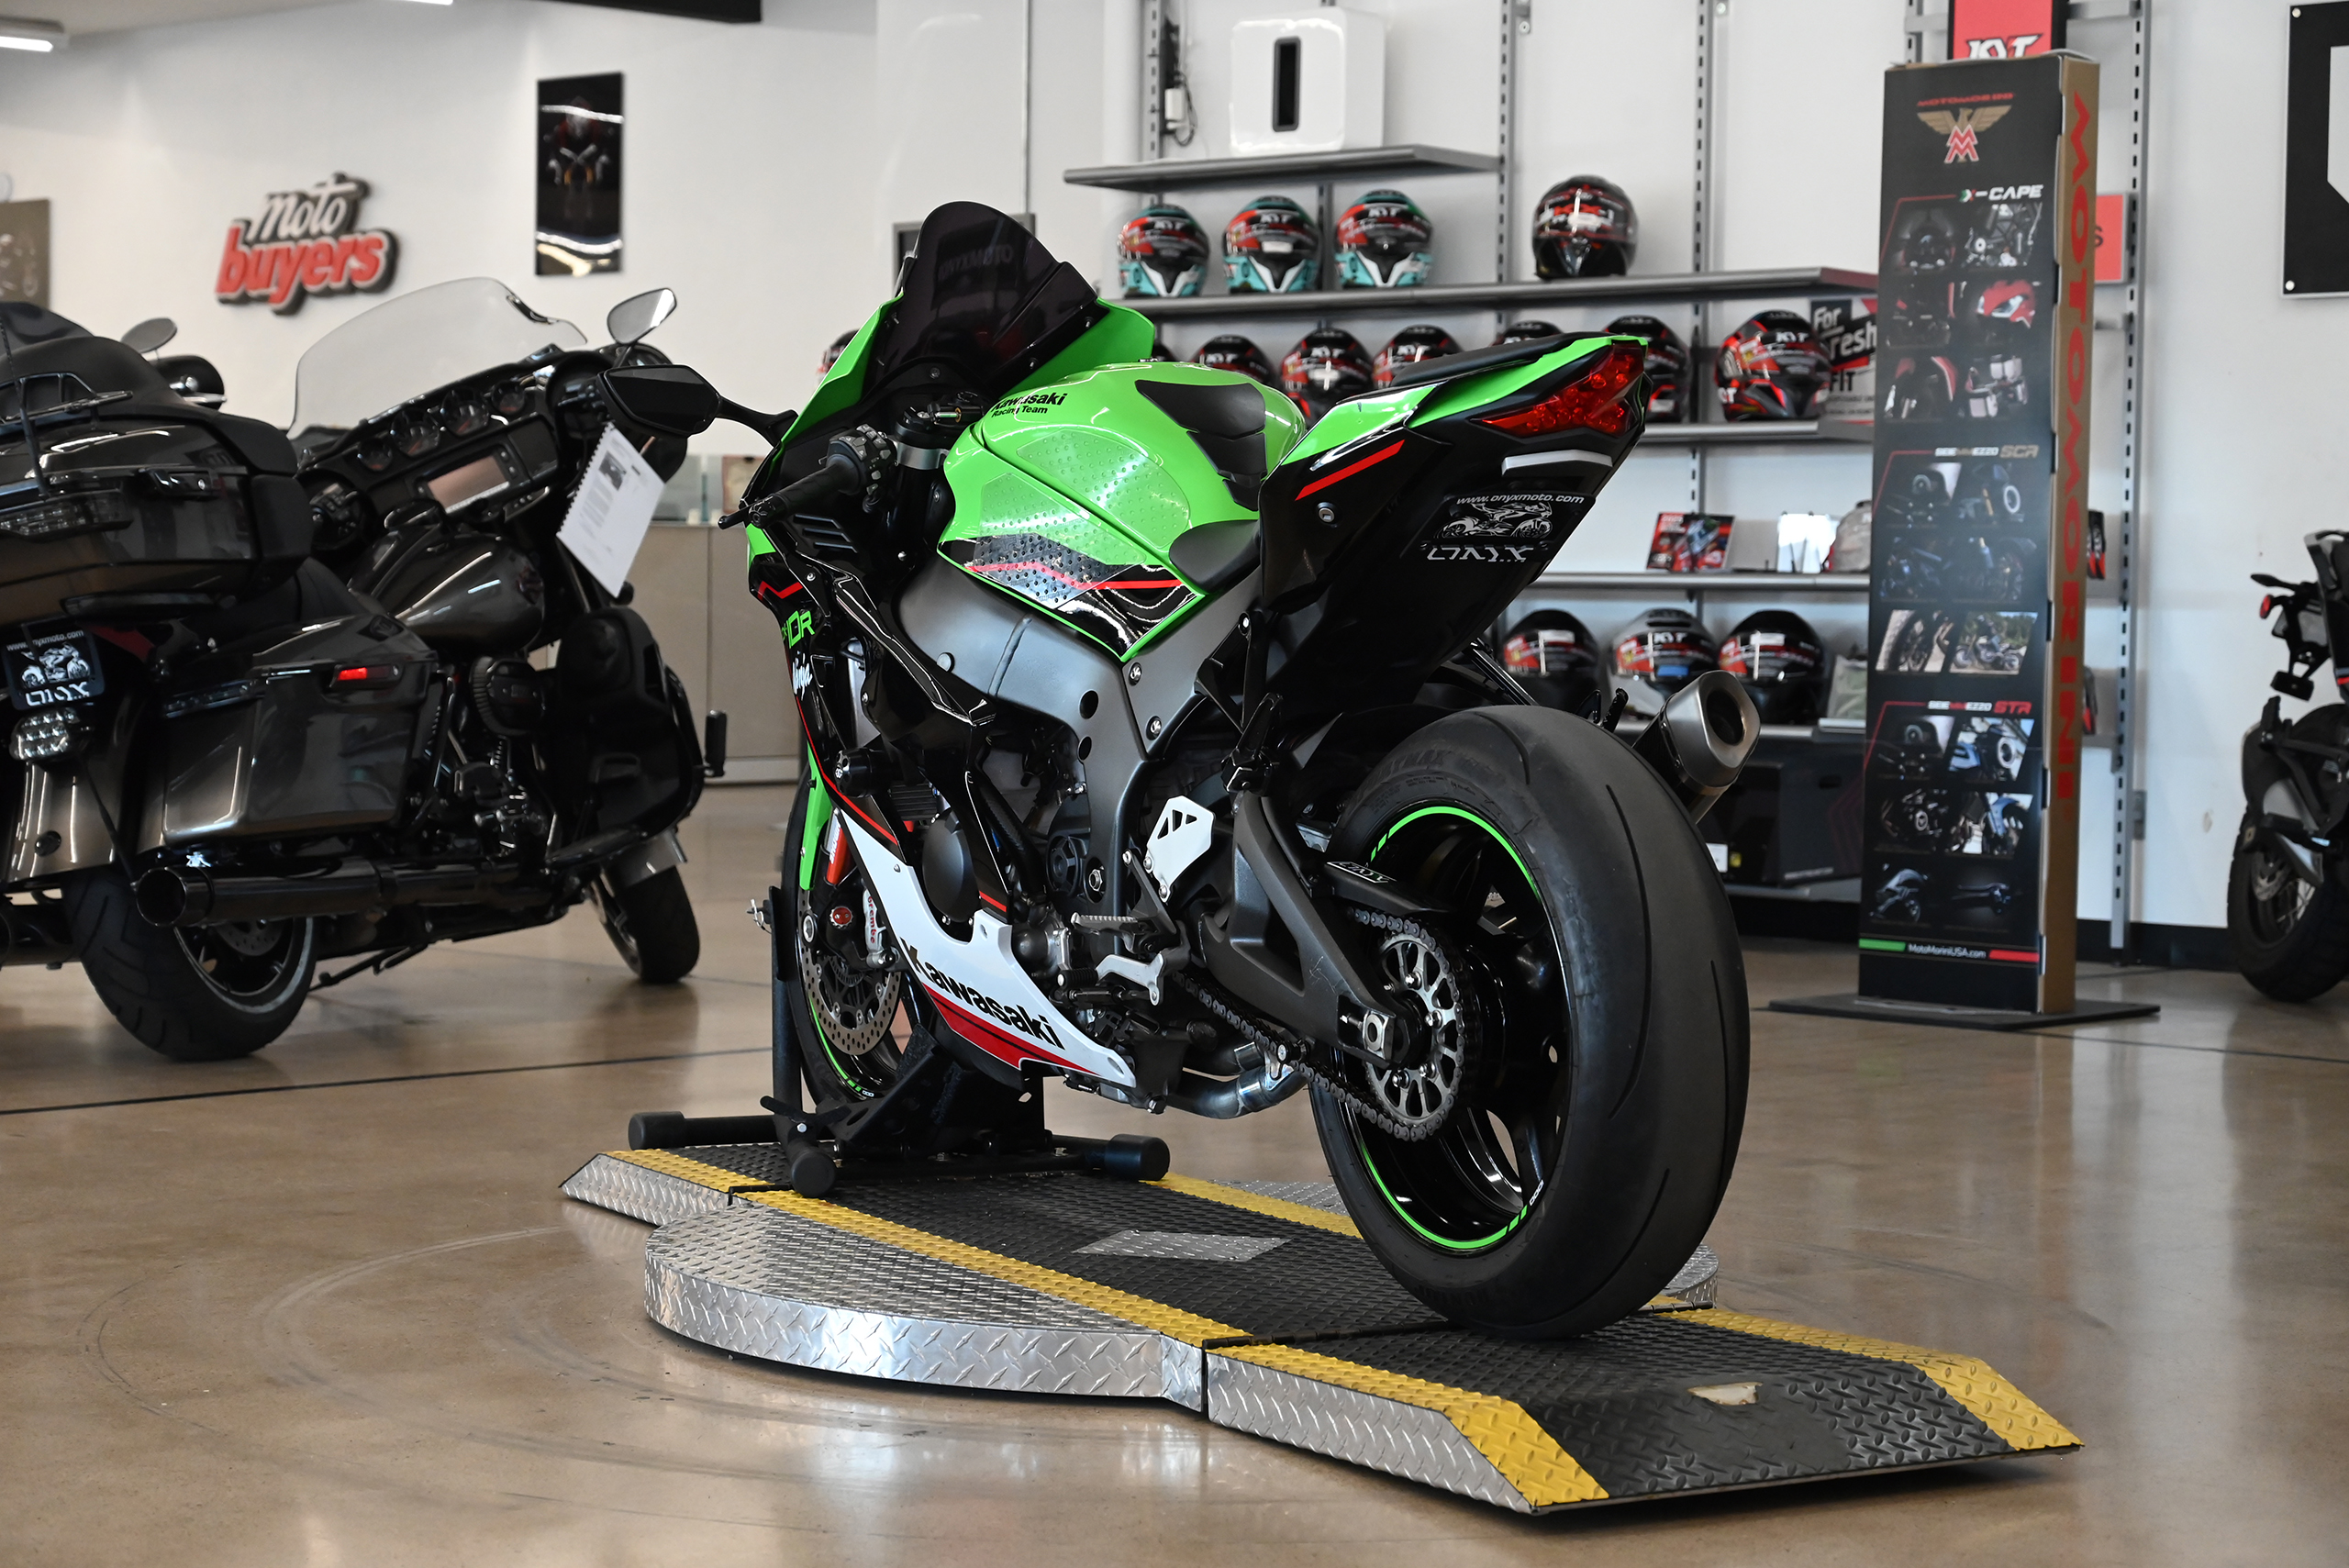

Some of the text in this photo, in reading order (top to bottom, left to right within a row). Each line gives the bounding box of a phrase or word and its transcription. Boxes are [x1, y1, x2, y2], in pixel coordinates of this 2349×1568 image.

[216, 226, 384, 304] buyers
[1813, 306, 1842, 330] For
[1776, 331, 1810, 343] KYT
[1021, 405, 1049, 414] Team
[1456, 493, 1586, 505] www.onyxmoto.com
[6, 629, 84, 651] www.nyxmoto.com
[1908, 942, 1987, 959] MotoMoriniUSA.com
[899, 936, 1065, 1051] Kawasaki
